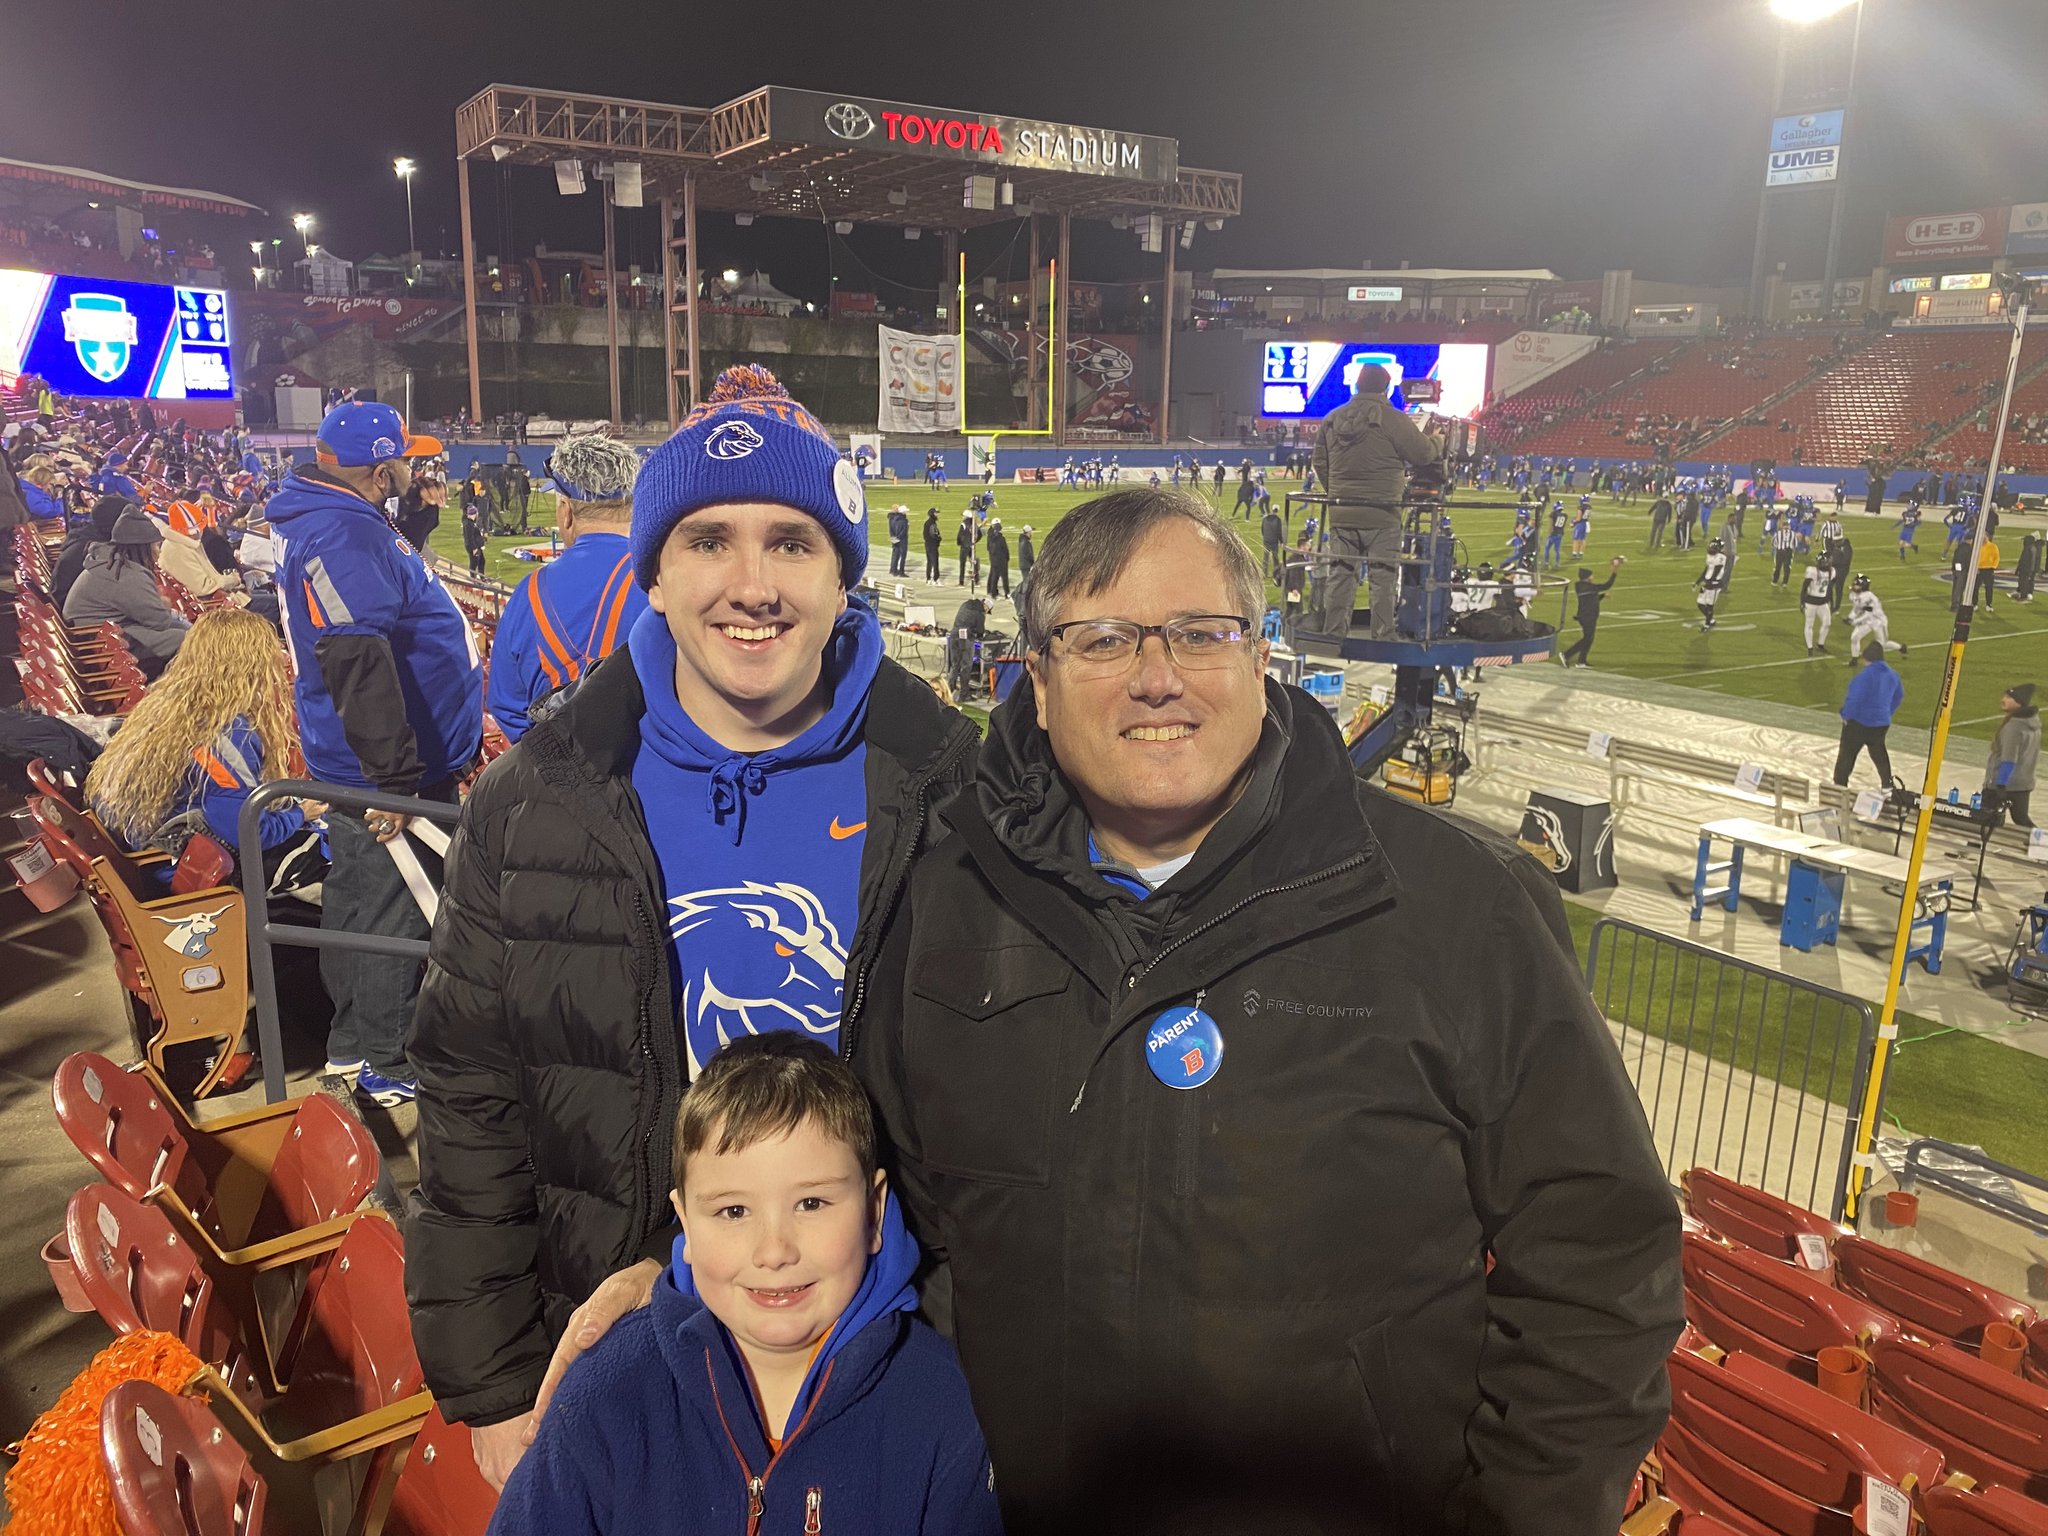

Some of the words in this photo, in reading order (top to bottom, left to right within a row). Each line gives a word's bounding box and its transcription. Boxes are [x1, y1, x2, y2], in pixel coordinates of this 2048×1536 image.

[882, 111, 1004, 154] TOYOTA
[1018, 129, 1141, 170] STADIUM
[1781, 128, 1832, 141] Gallagher
[1771, 149, 1835, 169] UMB
[1912, 279, 1932, 289] LIKE
[848, 497, 857, 515] B
[1555, 516, 1566, 528] 18
[1471, 586, 1487, 604] 27
[1914, 797, 1972, 818] PERADE
[196, 970, 206, 985] 6
[1266, 999, 1303, 1015] FREE
[1306, 1004, 1374, 1018] COUNTRY
[1148, 1010, 1200, 1053] PARENT
[1180, 1047, 1205, 1077] B
